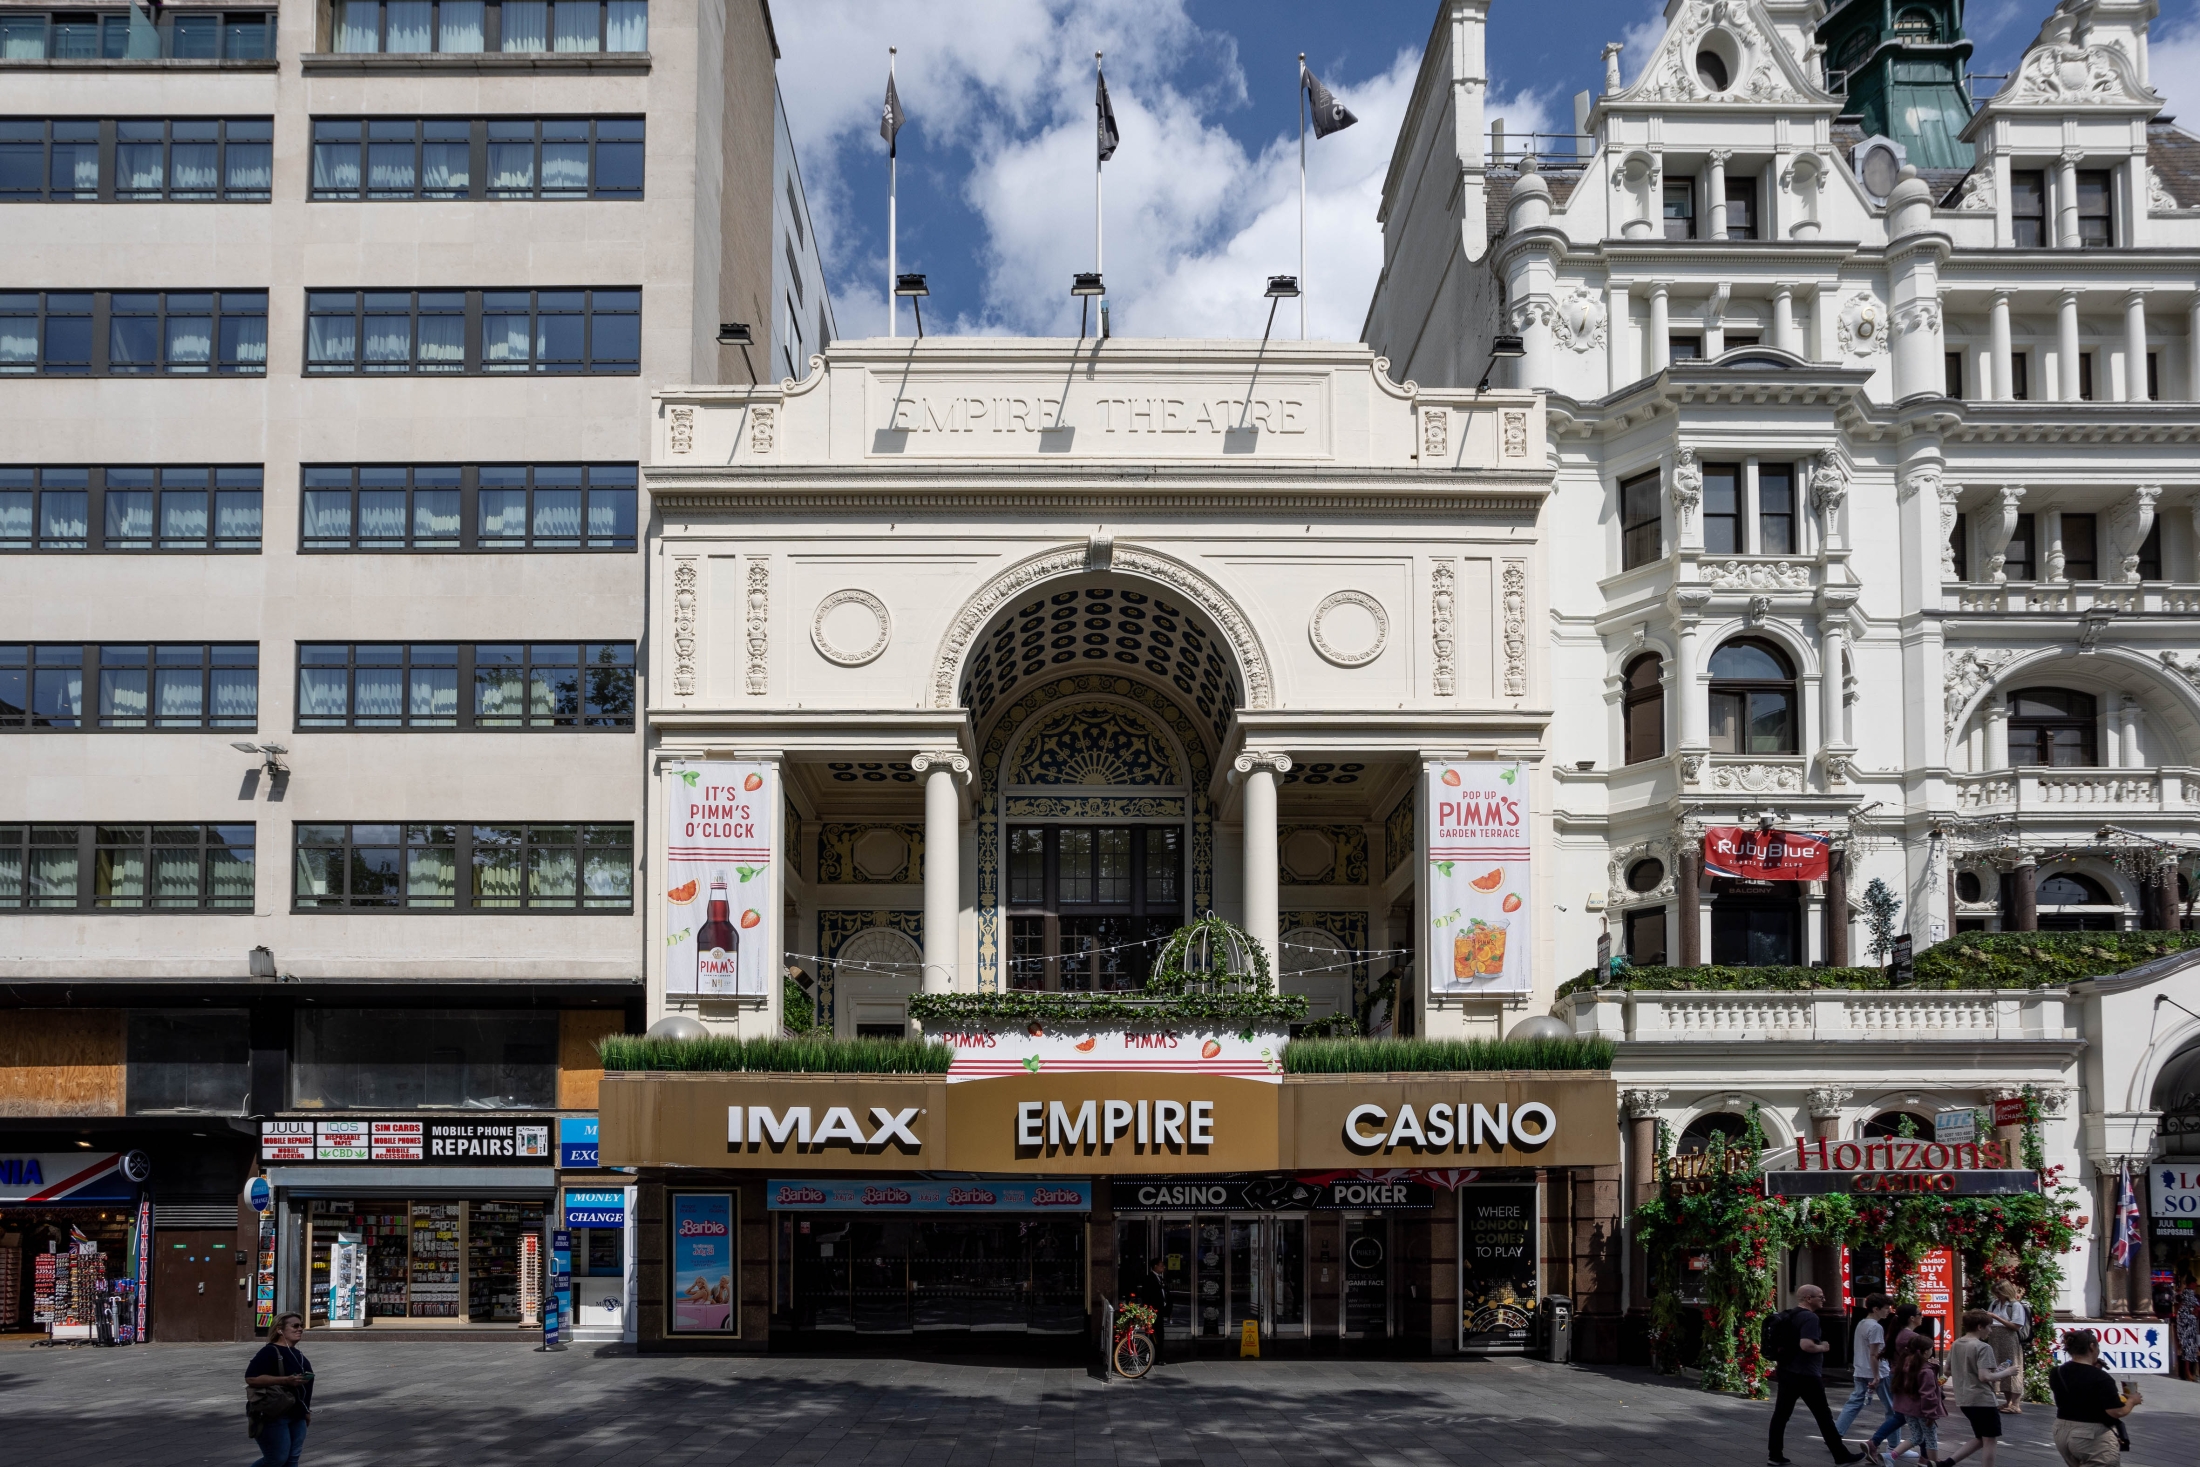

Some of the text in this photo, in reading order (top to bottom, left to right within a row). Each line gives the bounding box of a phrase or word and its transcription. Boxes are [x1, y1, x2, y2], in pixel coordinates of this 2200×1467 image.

[1861, 306, 1876, 338] 8
[891, 398, 1307, 434] EMPIRE THEATRE
[705, 786, 736, 802] IT'S
[1462, 791, 1497, 800] POP UP
[690, 803, 750, 820] PIMM'S
[1439, 796, 1520, 827] PIMM'S
[685, 822, 755, 839] O'CLOCK
[1439, 828, 1520, 838] GARDEN TERRACE
[1717, 838, 1815, 860] RubyBlue
[700, 958, 735, 974] PIMM'S
[943, 1028, 997, 1049] PIMM'S
[1124, 1028, 1178, 1049] PIMM'S
[269, 1122, 307, 1133] JUUL
[326, 1122, 359, 1133] IQOS
[374, 1124, 421, 1132] SIM CARDS
[727, 1105, 922, 1145] IMAX
[1018, 1099, 1214, 1145] EMPIRE
[1345, 1101, 1557, 1147] CASINO
[1937, 1113, 1971, 1128] LITE
[432, 1126, 474, 1136] MOBILE
[477, 1126, 514, 1136] PHONE
[287, 1136, 313, 1144] REPAIRS
[431, 1139, 514, 1156] REPAIRS
[332, 1148, 353, 1158] CBD
[1794, 1134, 2006, 1171] Horizons
[1855, 1173, 1956, 1192] CASINO
[573, 1193, 622, 1202] MONEY
[777, 1186, 824, 1203] Barbie
[861, 1186, 908, 1203] Barbie
[946, 1186, 994, 1203] Barbie
[1032, 1186, 1079, 1203] Barbie
[1137, 1185, 1227, 1205] CASINO
[1334, 1185, 1407, 1204] POKER
[569, 1212, 624, 1222] CHANGE
[1477, 1206, 1520, 1217] WHERE
[678, 1219, 726, 1236] Barbie
[1470, 1219, 1529, 1231] LONDON
[2177, 1219, 2194, 1228] CBD
[1475, 1233, 1525, 1244] COMES
[2155, 1228, 2195, 1236] DISPOSABLE
[260, 1252, 274, 1260] SIM
[692, 1247, 707, 1256] July
[1476, 1247, 1523, 1258] TO PLAY
[1920, 1265, 1944, 1273] BUY
